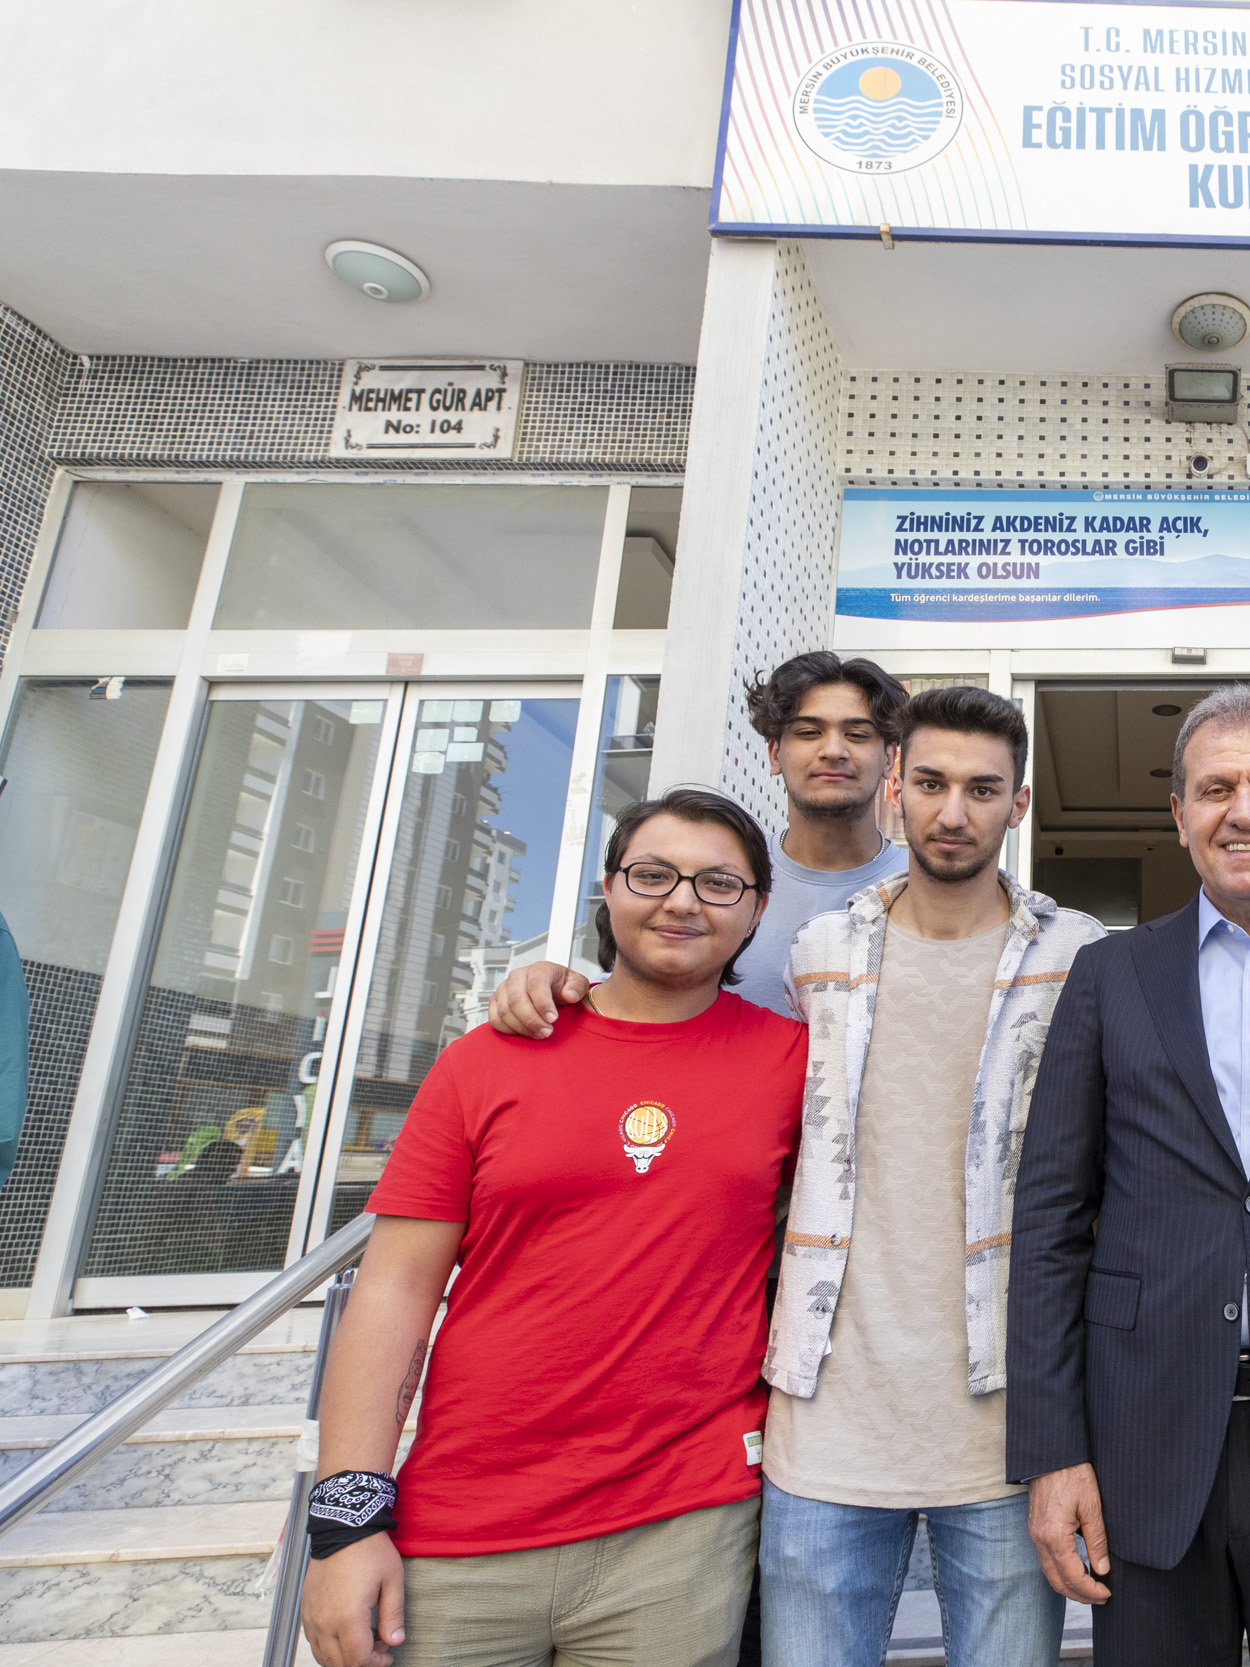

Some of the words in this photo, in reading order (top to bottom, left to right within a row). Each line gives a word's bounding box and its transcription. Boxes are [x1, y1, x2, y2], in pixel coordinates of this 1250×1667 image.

[1079, 26, 1130, 53] T.C.
[1143, 28, 1247, 57] MERSİN
[799, 71, 823, 115] MERSİN
[917, 57, 957, 119] BELEDİYESİ
[1060, 64, 1165, 92] SOSYAL
[1022, 101, 1167, 152] EĞİTİM
[856, 161, 892, 170] 1873
[348, 388, 426, 412] MEHMET
[428, 382, 467, 412] GÜR
[469, 388, 507, 412] APT
[384, 419, 420, 435] No:
[430, 419, 463, 434] 104
[1147, 493, 1210, 501] BÜYÜKŞEHİR
[895, 511, 985, 533] ZİHNİNİZ
[991, 512, 1077, 533] AKDENİZ
[1084, 515, 1151, 534] KADAR
[1158, 516, 1210, 539] AÇIK,
[894, 538, 1012, 556] NOTLARINIZ
[1018, 538, 1118, 556] TOROSLAR
[1124, 535, 1165, 557] GİBİ
[892, 557, 970, 580] YÜKSEK
[976, 561, 1041, 580] OLSUN
[890, 593, 911, 602] Tüm
[913, 593, 950, 605] öğrenci
[952, 593, 1017, 605] kardeşlerime
[1018, 593, 1062, 605] başarılar
[1063, 593, 1101, 602] dilerim.
[619, 1103, 638, 1124] CHICAGO
[640, 1100, 665, 1108] CHICAGO
[625, 1107, 668, 1143] BULLS
